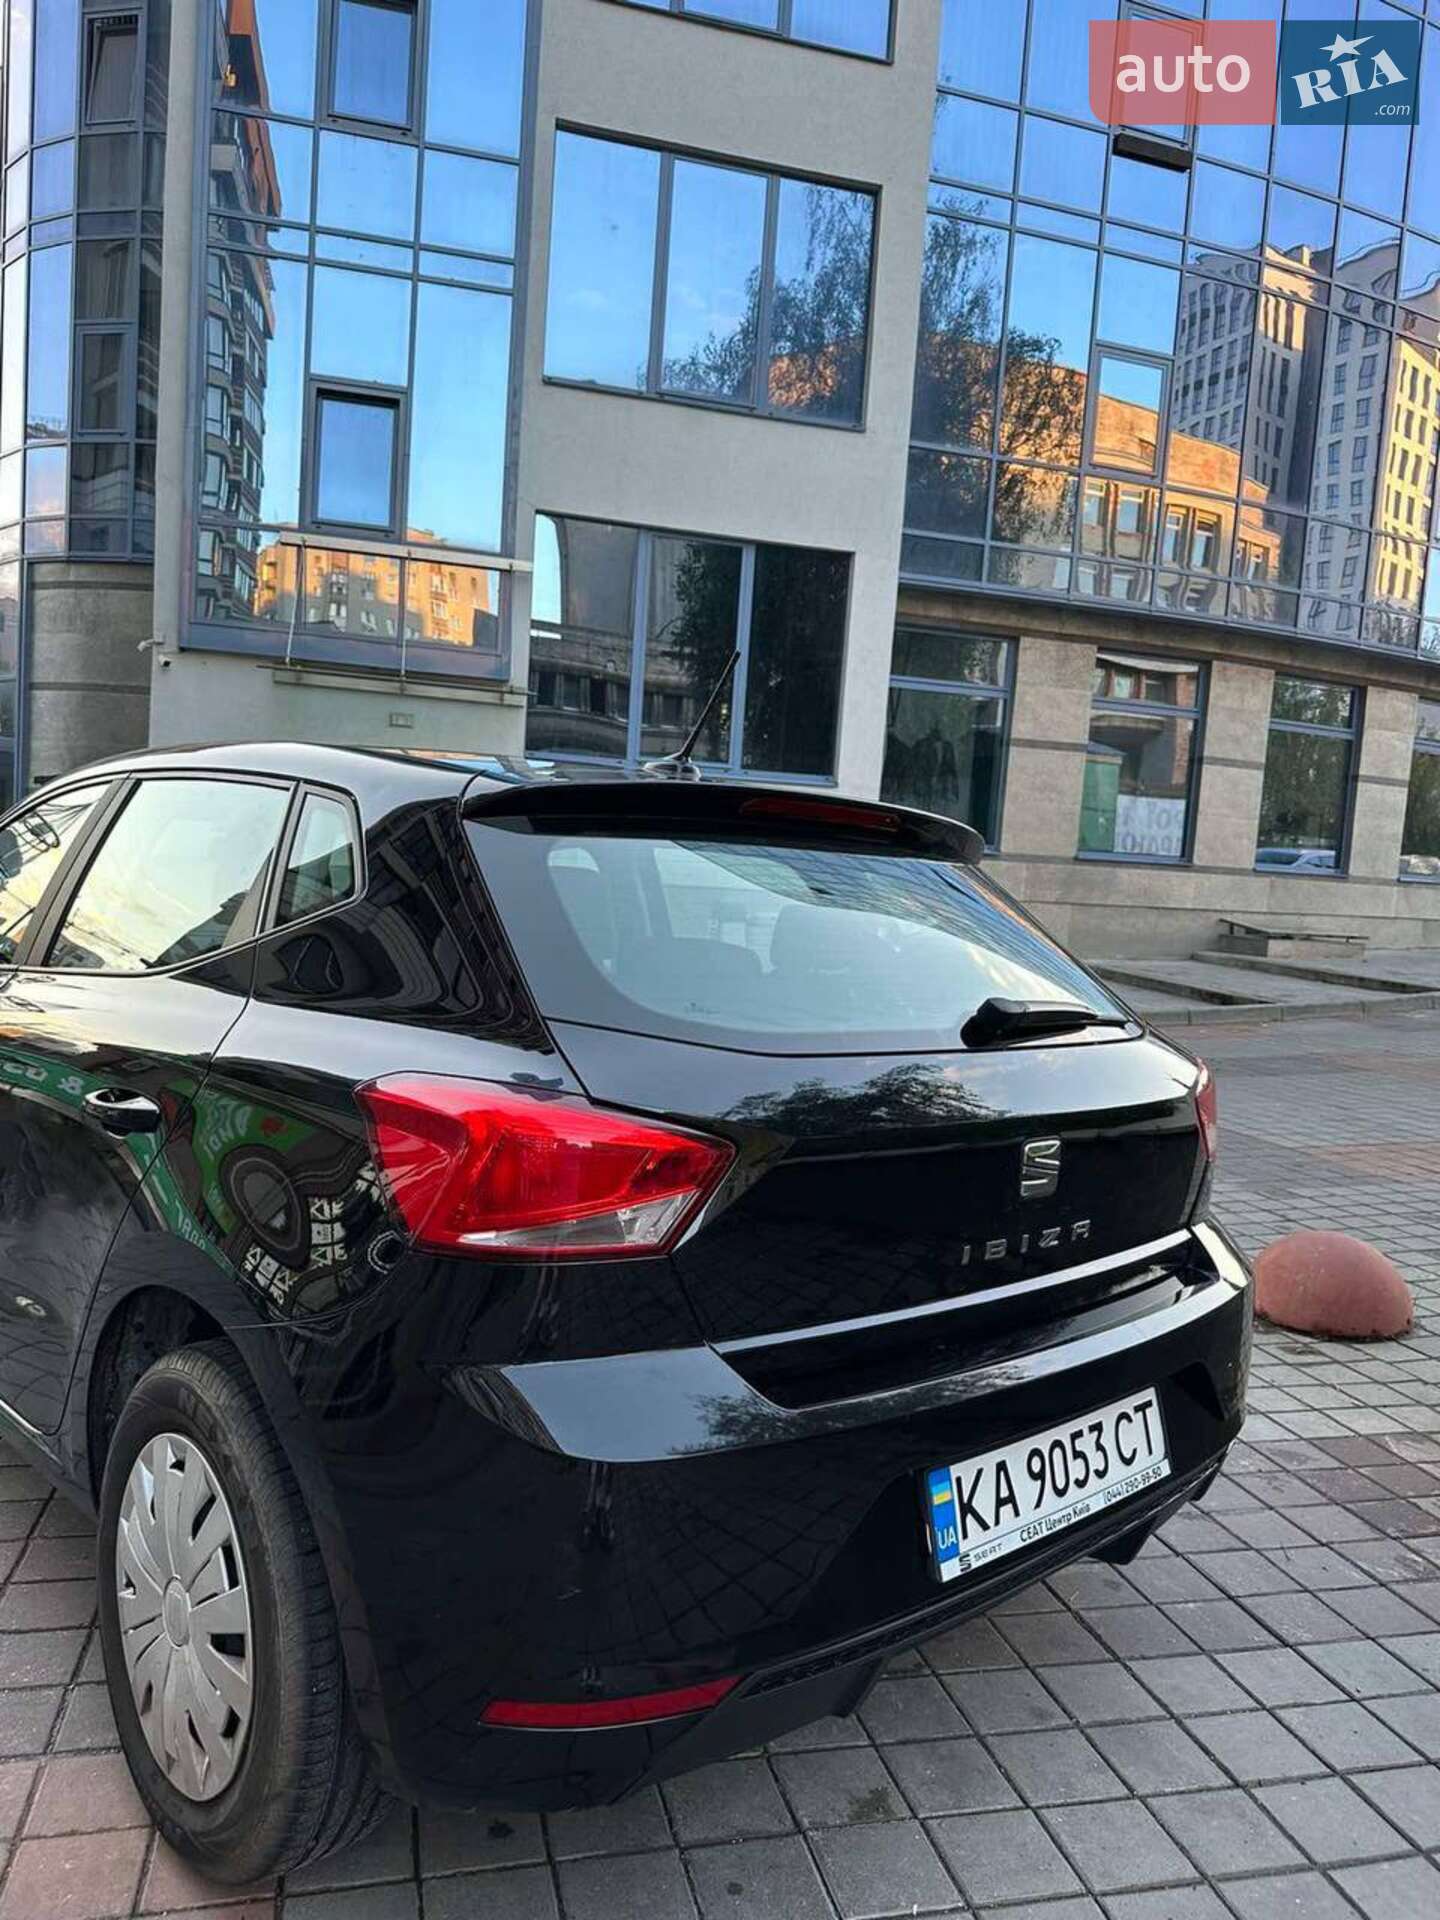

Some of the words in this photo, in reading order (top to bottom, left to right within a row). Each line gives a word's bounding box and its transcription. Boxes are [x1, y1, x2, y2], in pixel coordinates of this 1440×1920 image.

[961, 1220, 1091, 1265] IBIZA
[956, 1460, 1020, 1540] KA
[1026, 1421, 1109, 1510] 9053
[1115, 1399, 1153, 1466] CT
[937, 1526, 957, 1549] UA
